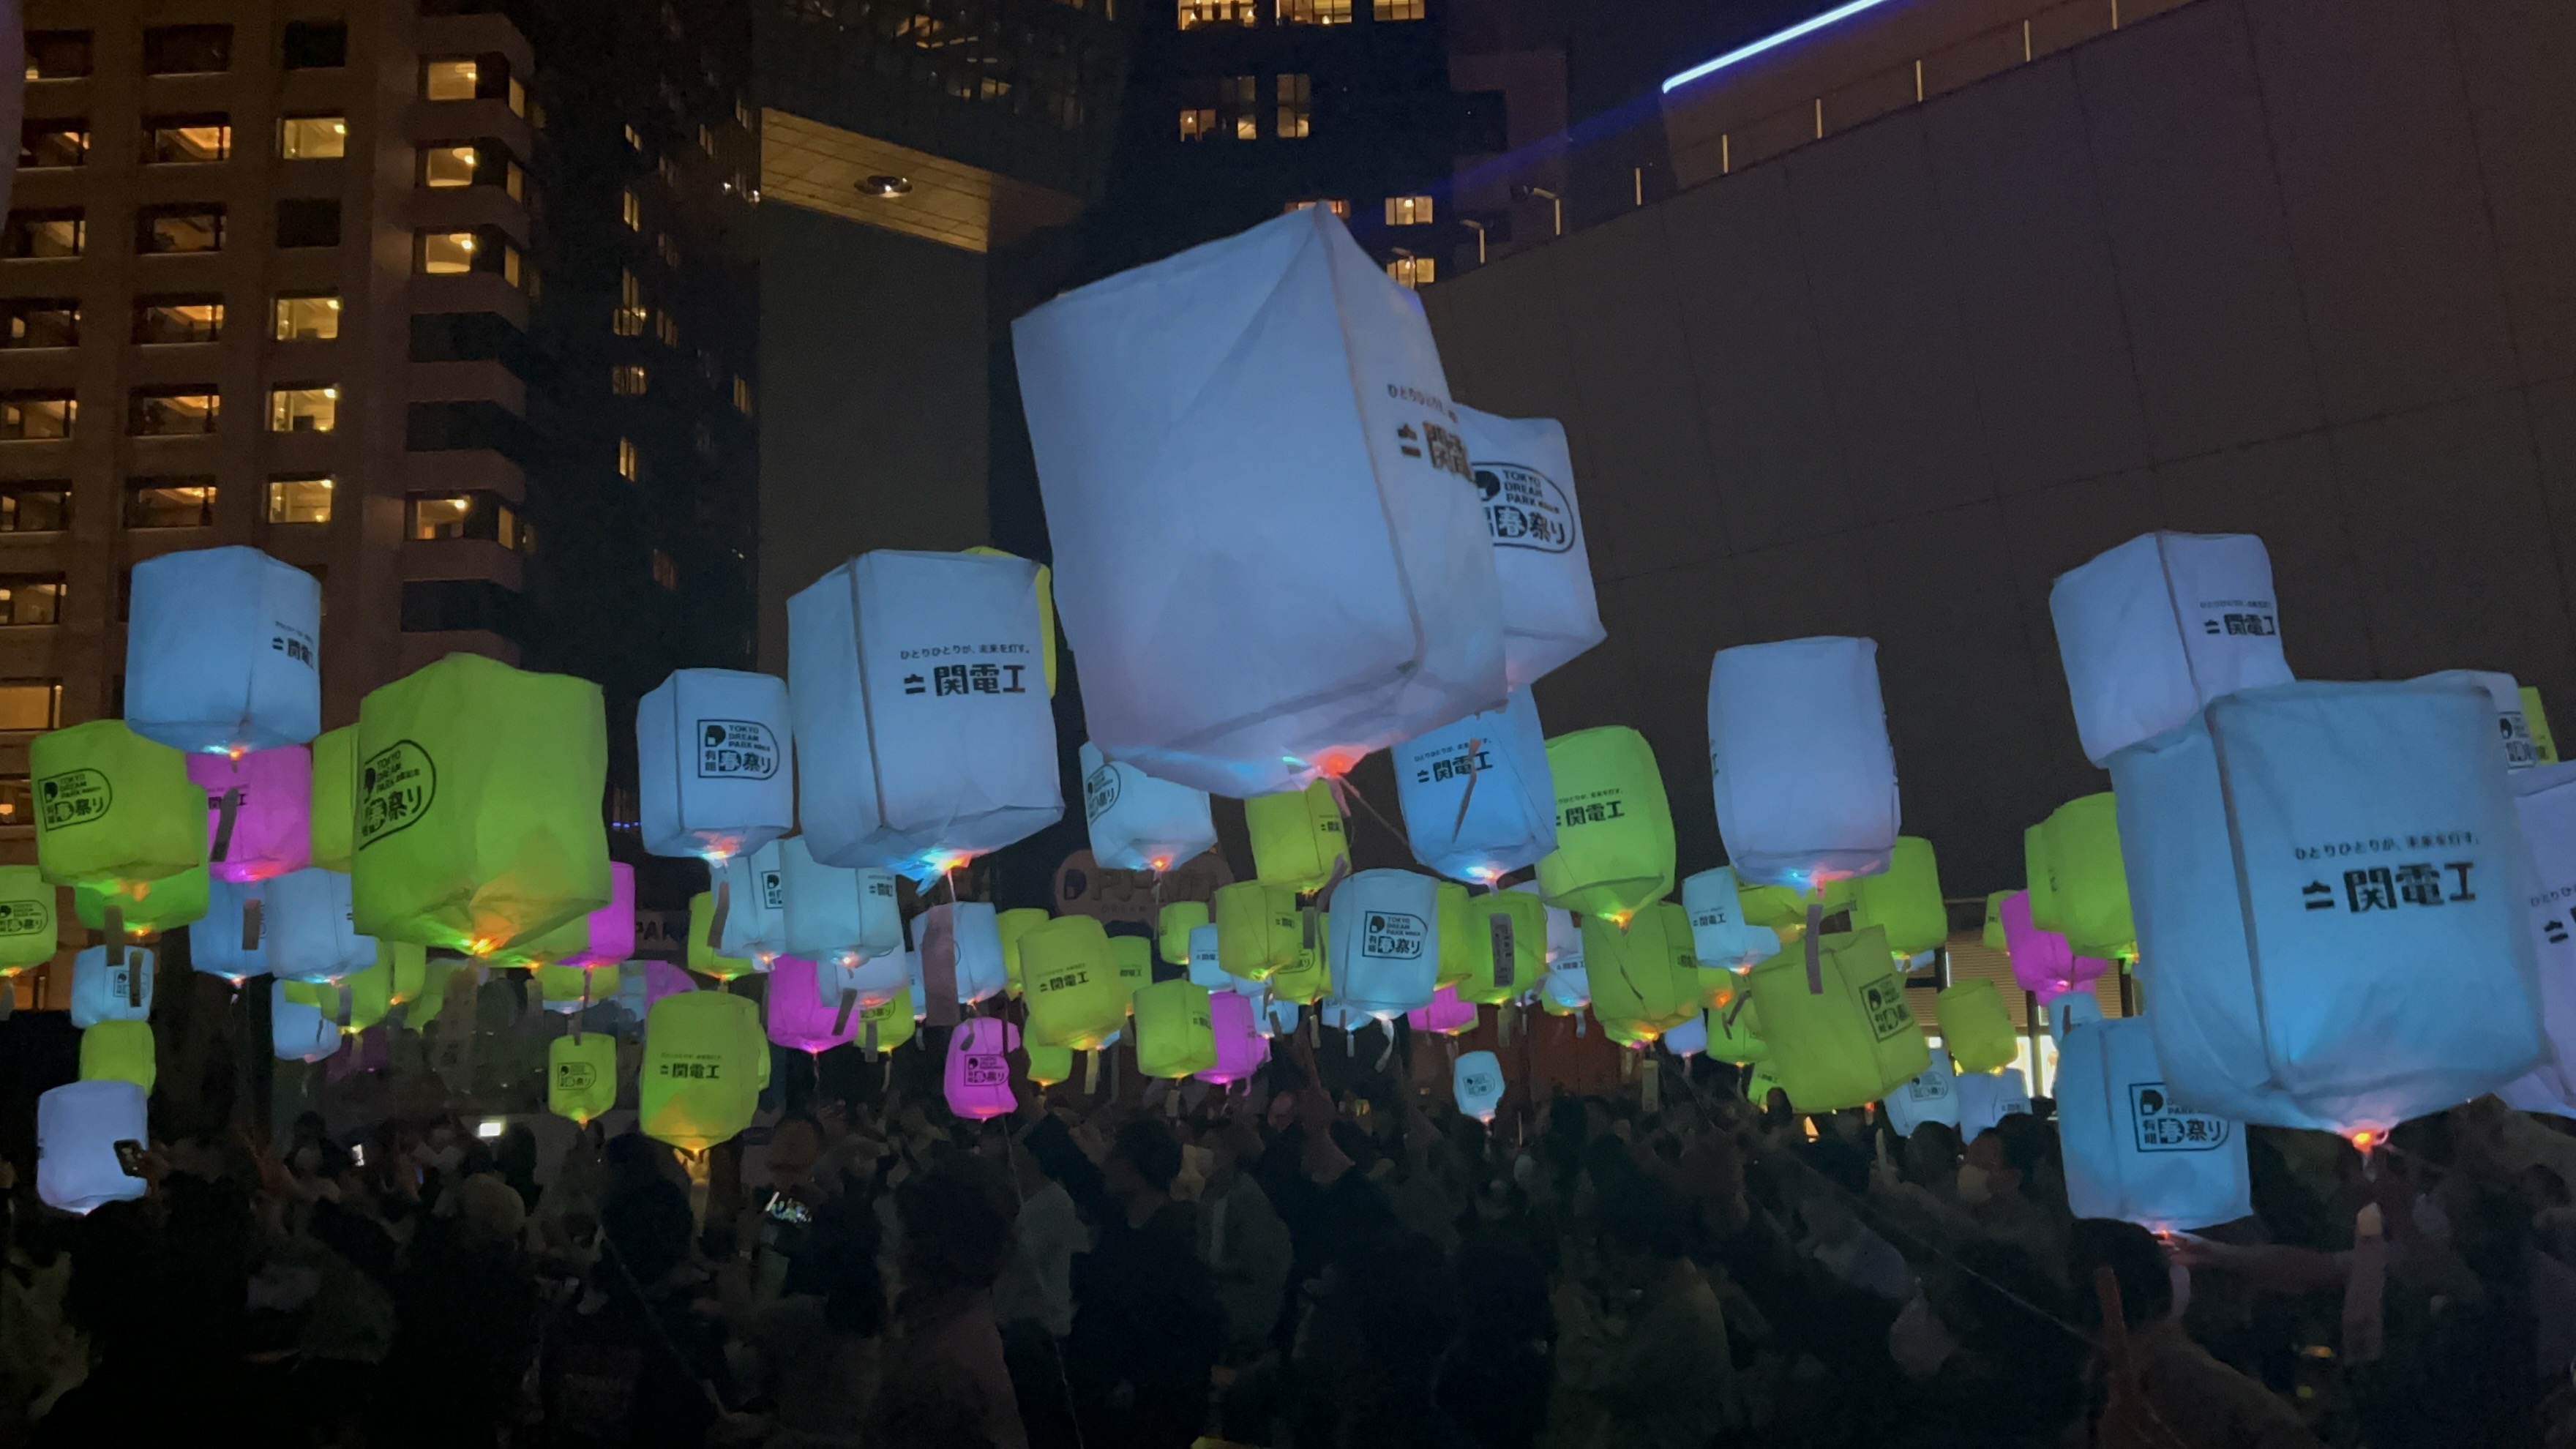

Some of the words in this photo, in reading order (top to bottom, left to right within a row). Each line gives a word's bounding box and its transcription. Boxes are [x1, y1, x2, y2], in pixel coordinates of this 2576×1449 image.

[1506, 493, 1535, 506] PARK
[934, 664, 1026, 697] 関電工
[729, 724, 760, 734] TOKYO
[729, 733, 760, 741] DREAM
[728, 741, 753, 749] PARK
[1433, 751, 1493, 782] 関電工
[208, 793, 247, 810] 関工
[1565, 800, 1625, 828] 関電工
[2343, 861, 2477, 913] 関電工
[673, 1063, 720, 1079] 関電工
